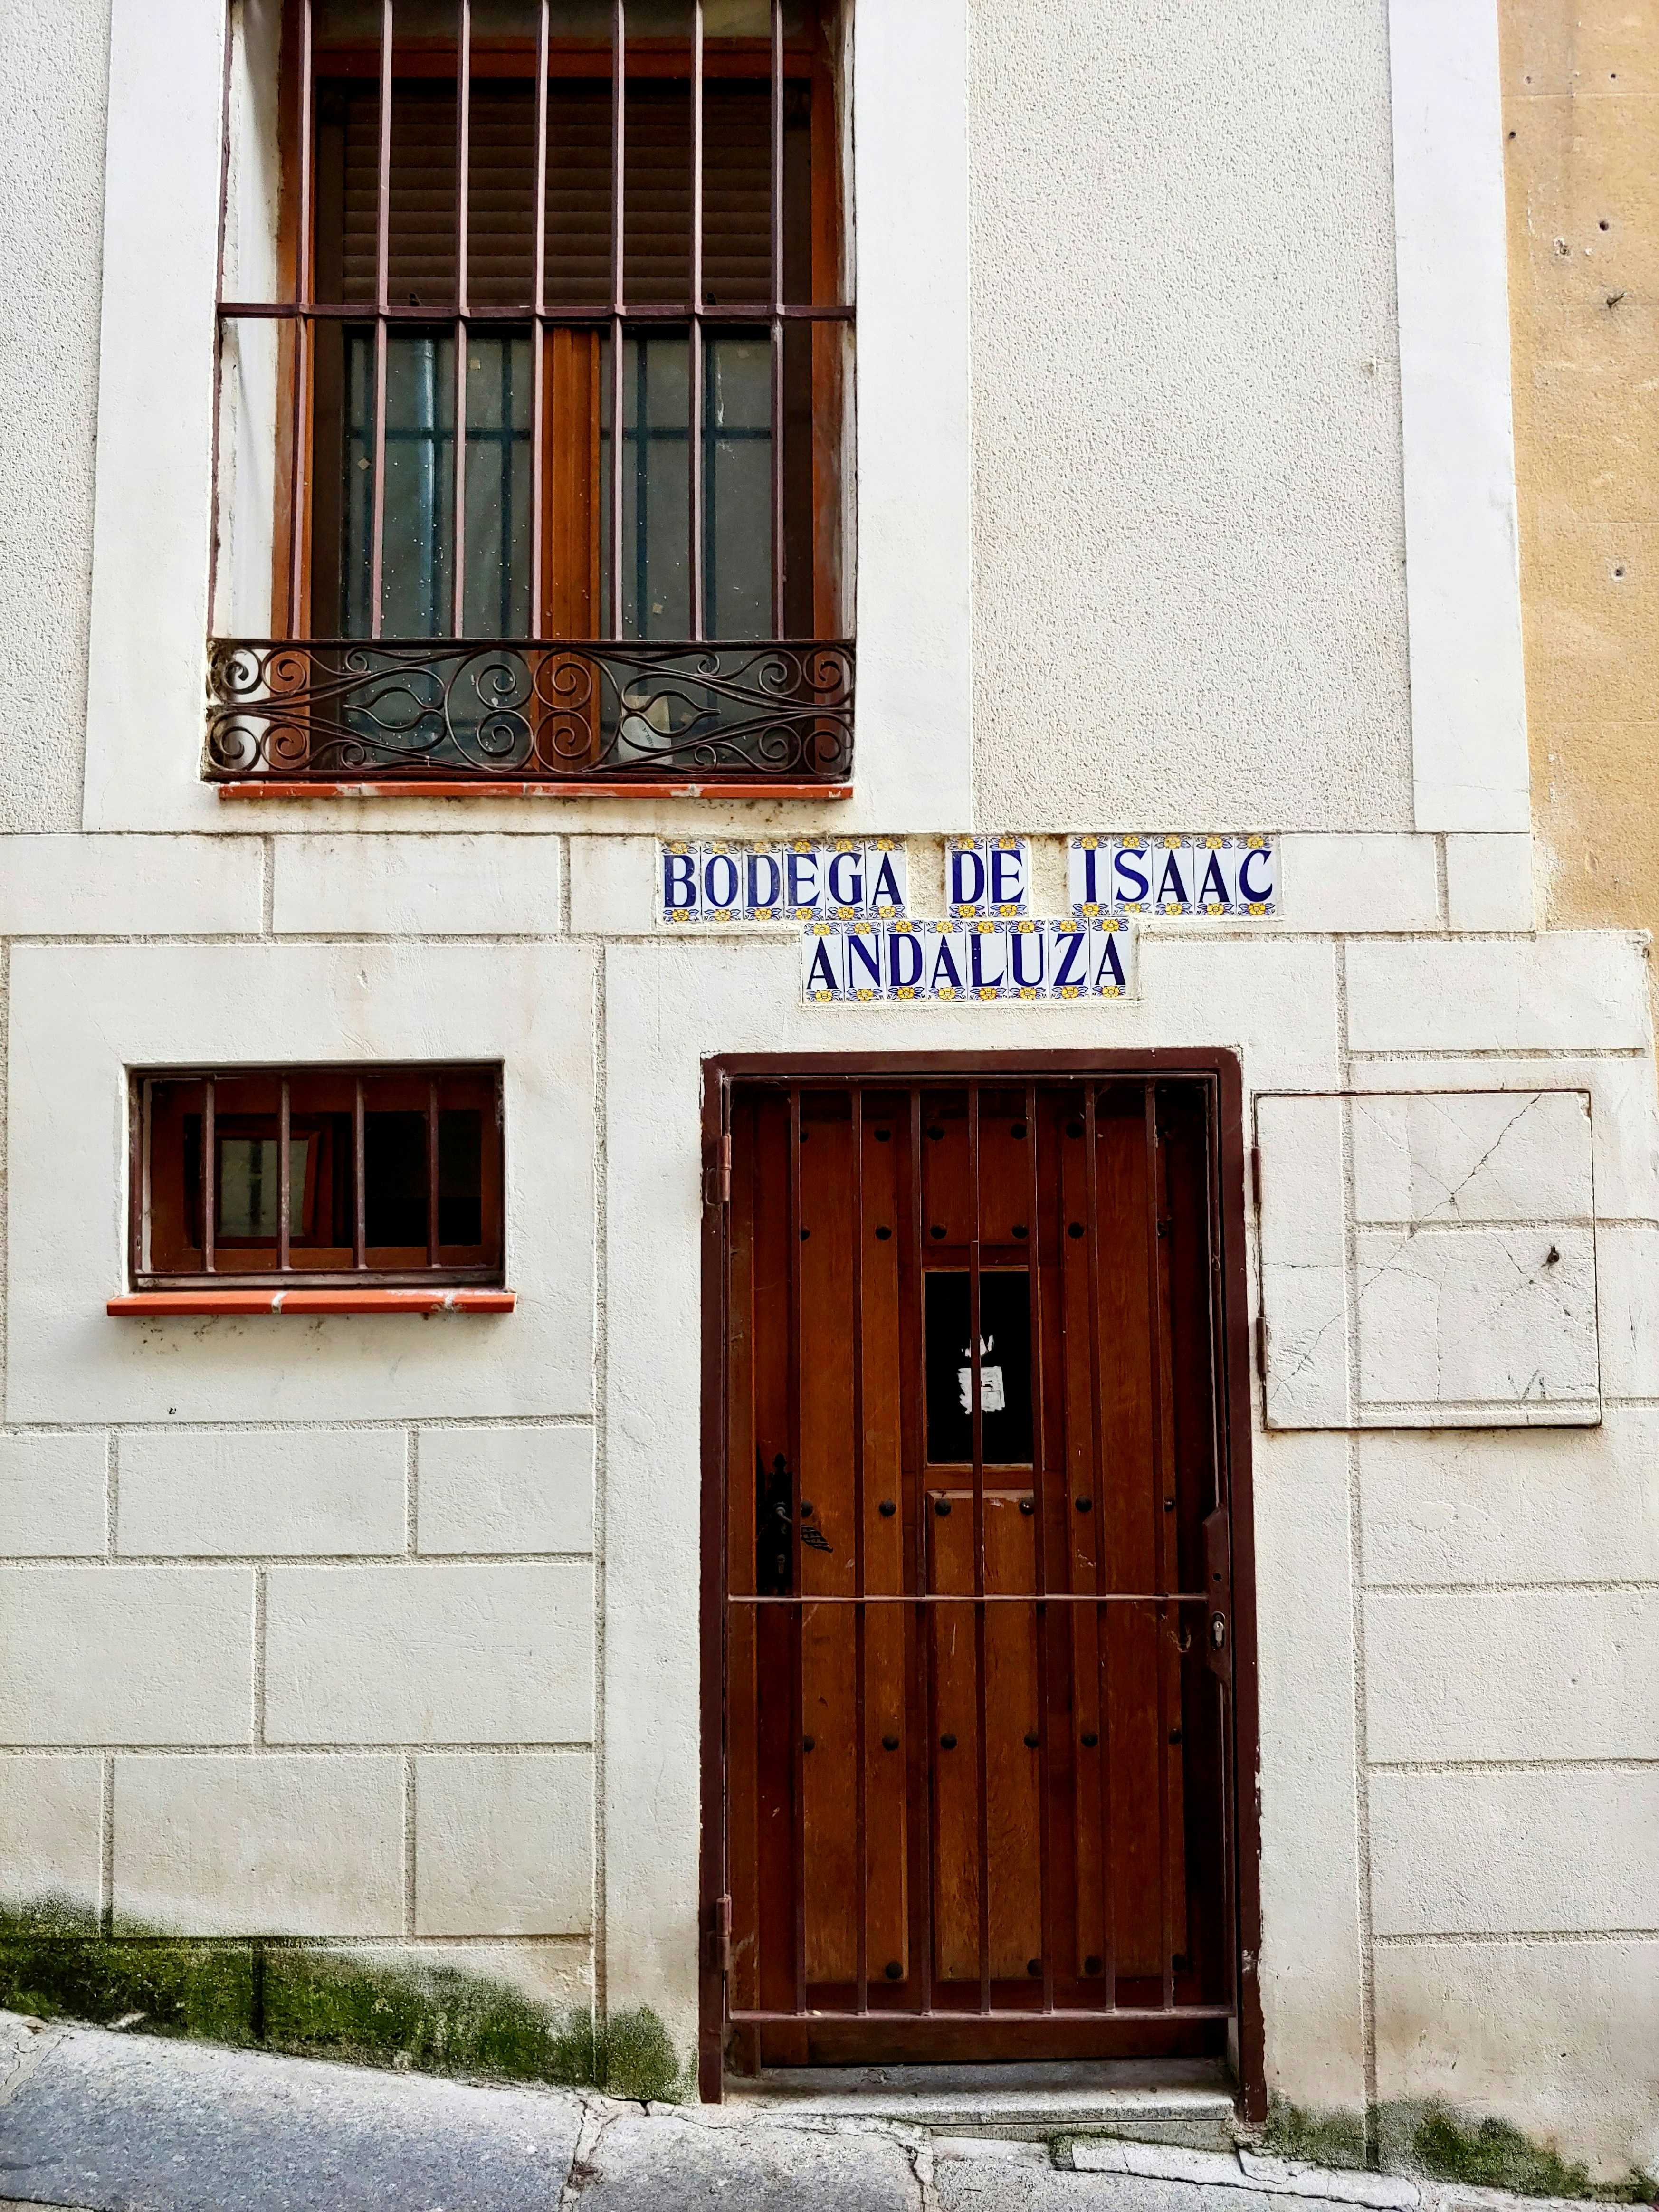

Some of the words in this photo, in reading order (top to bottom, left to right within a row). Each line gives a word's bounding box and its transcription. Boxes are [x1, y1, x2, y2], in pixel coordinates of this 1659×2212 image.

[664, 852, 904, 908] BODEGA
[951, 849, 1025, 904] DE
[1083, 849, 1273, 903] ISAAC
[806, 932, 1126, 990] ANDALUZA
